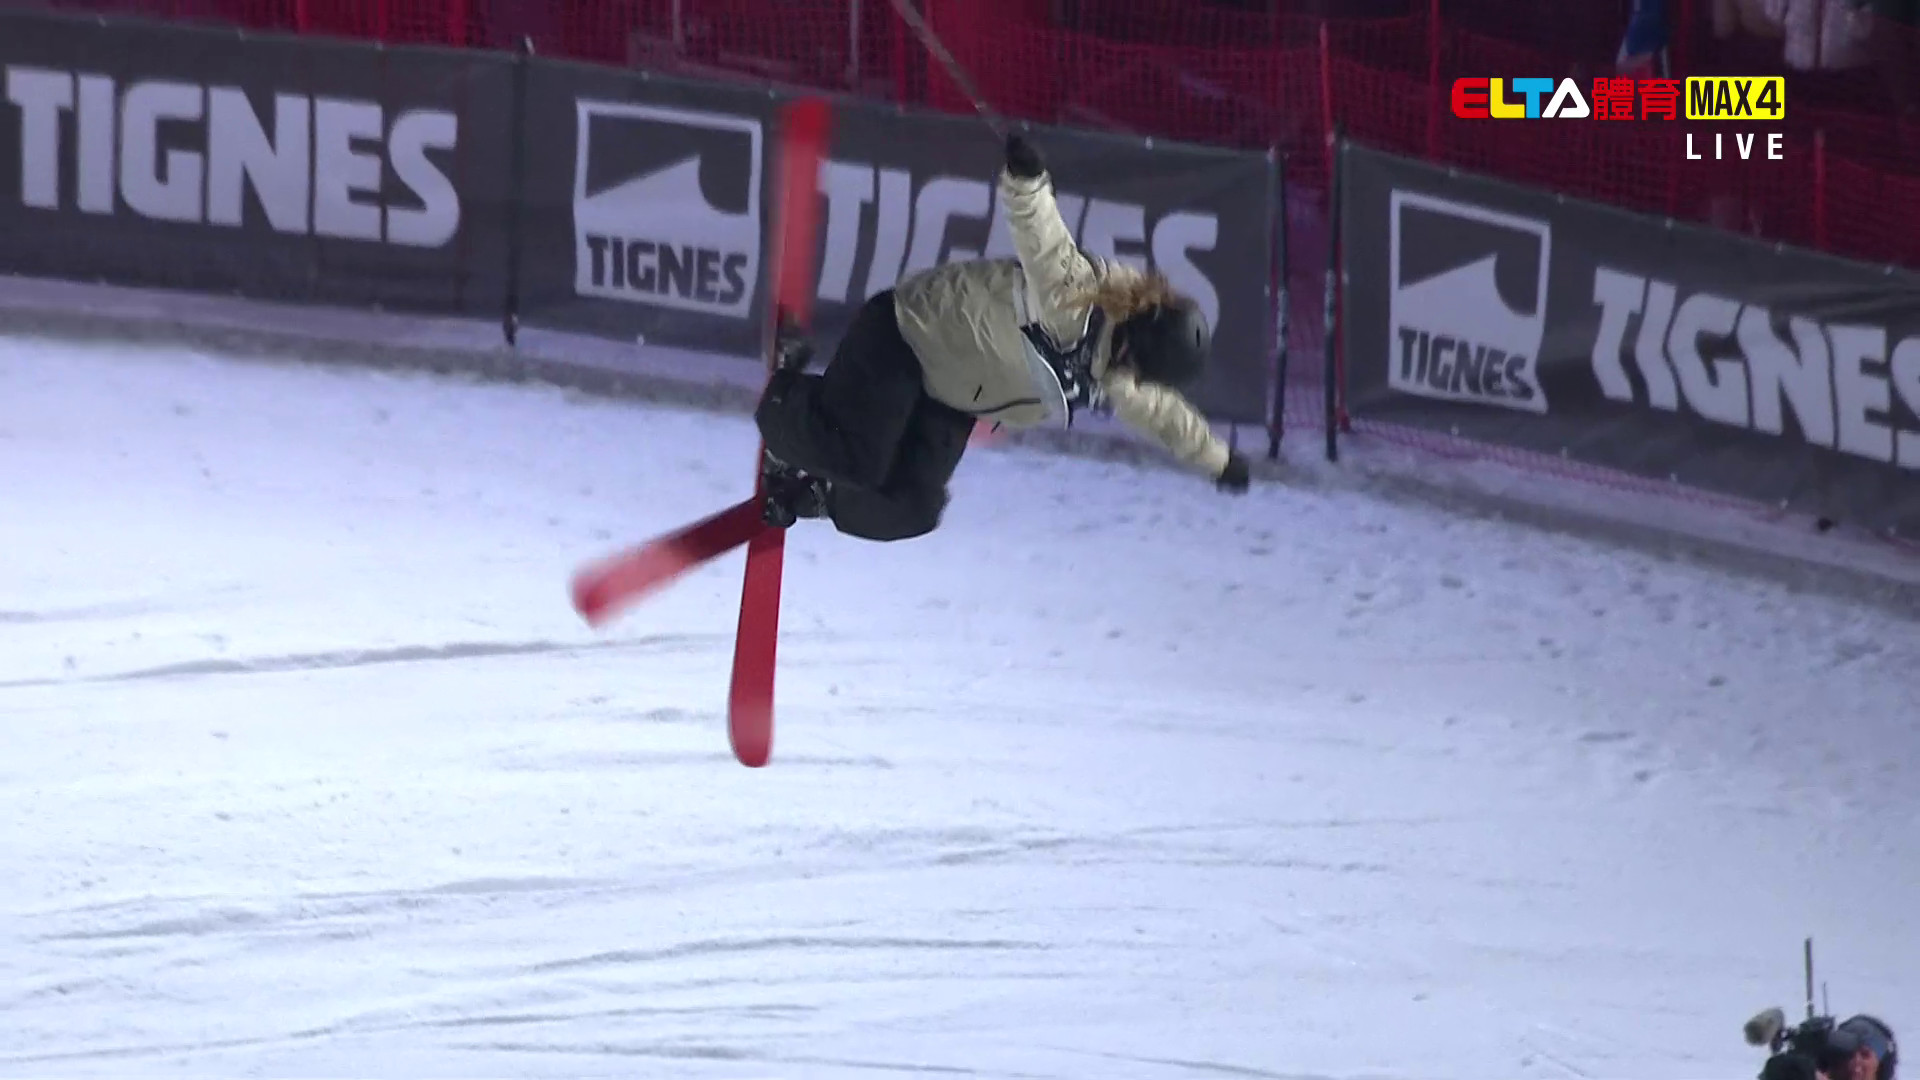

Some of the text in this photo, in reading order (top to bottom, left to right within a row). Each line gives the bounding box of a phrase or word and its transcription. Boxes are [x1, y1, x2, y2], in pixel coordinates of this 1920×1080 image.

[5, 66, 461, 247] TIGNES
[586, 234, 747, 304] TIGNES
[1398, 328, 1533, 400] TIGNES
